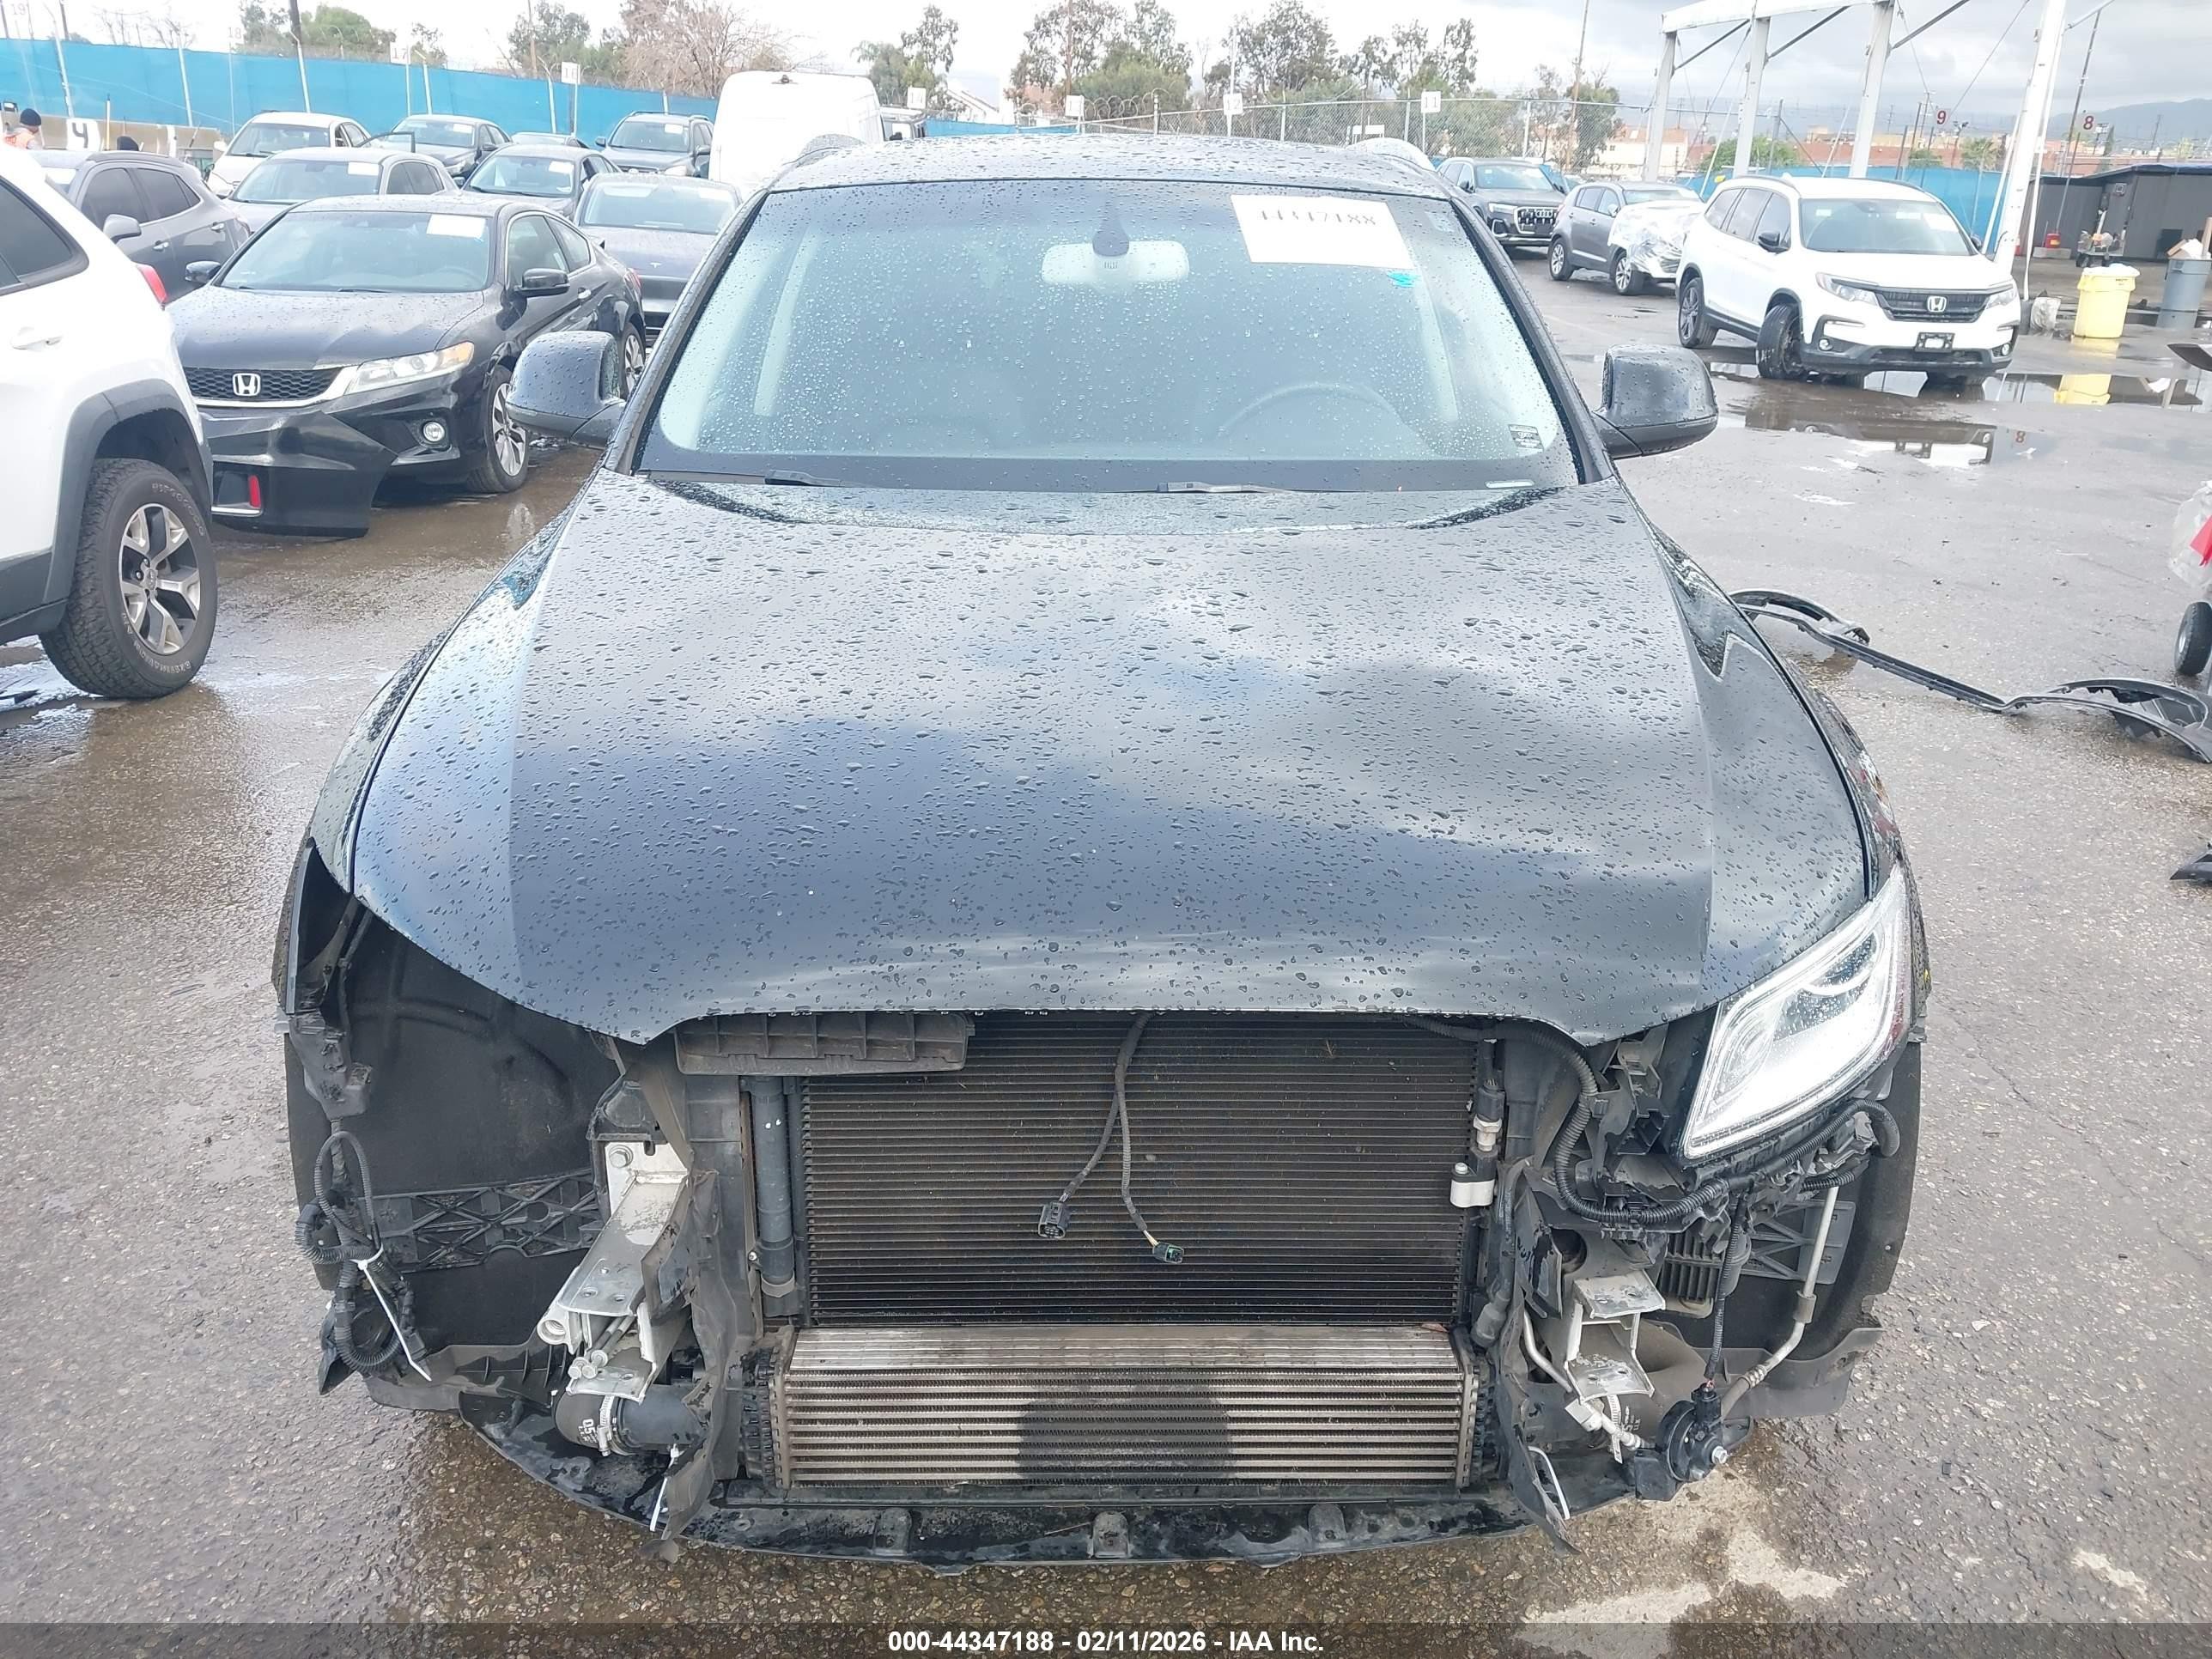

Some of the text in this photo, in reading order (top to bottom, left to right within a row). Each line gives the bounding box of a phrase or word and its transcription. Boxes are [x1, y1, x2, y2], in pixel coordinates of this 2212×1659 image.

[1936, 110, 1947, 125] 9
[2083, 115, 2094, 130] 8
[71, 122, 89, 149] 4
